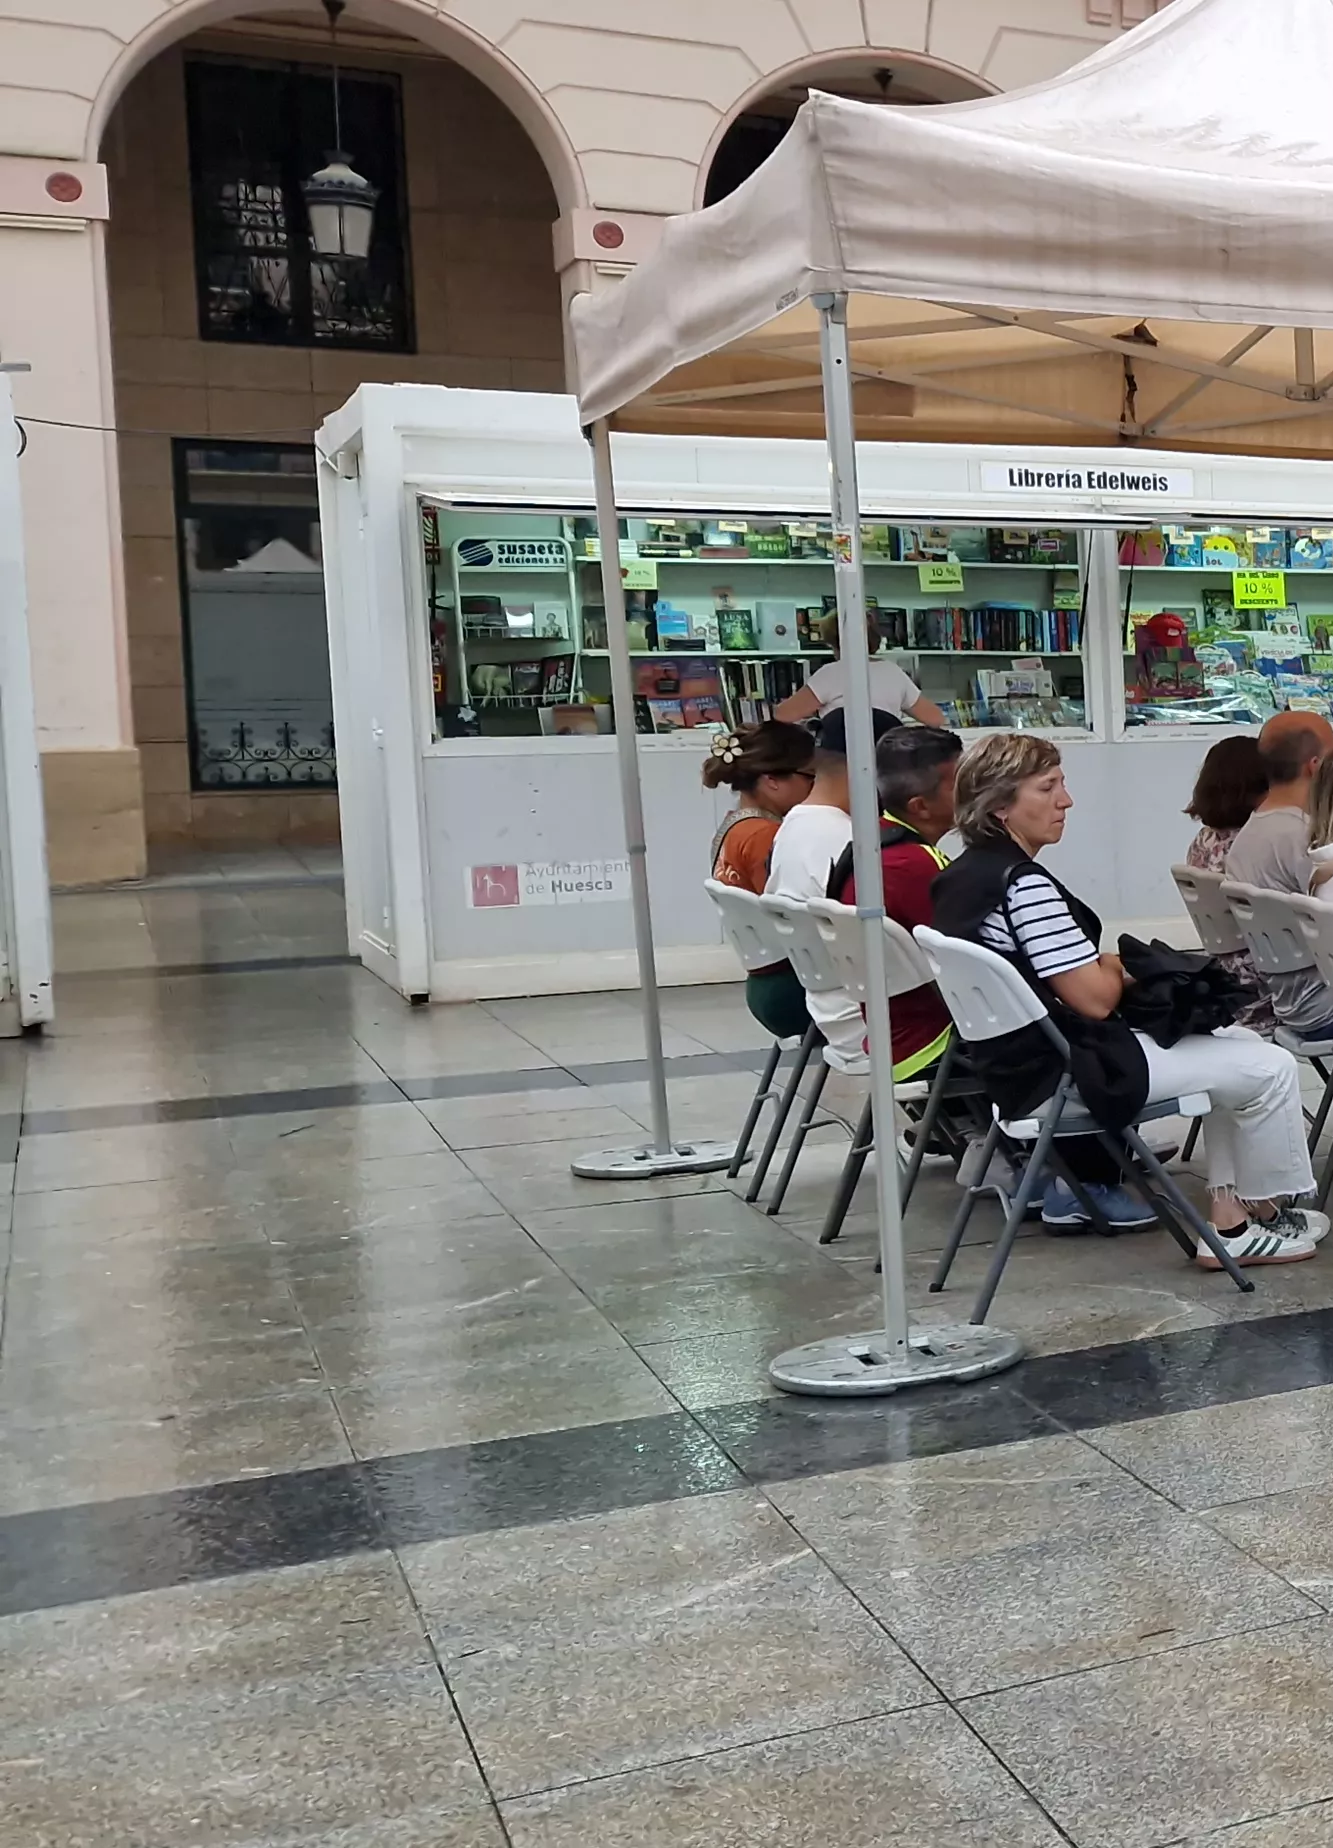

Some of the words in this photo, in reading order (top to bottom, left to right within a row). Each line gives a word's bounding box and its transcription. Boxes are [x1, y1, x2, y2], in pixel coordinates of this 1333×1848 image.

[1008, 467, 1083, 490] Librería
[1086, 470, 1169, 492] Edelweis
[497, 543, 564, 555] susaeta
[498, 556, 550, 564] ediciones
[1244, 582, 1258, 594] 10
[1261, 582, 1273, 594] %
[525, 861, 630, 878] Ayuntamient
[526, 884, 545, 895] de
[551, 880, 613, 893] Huesca
